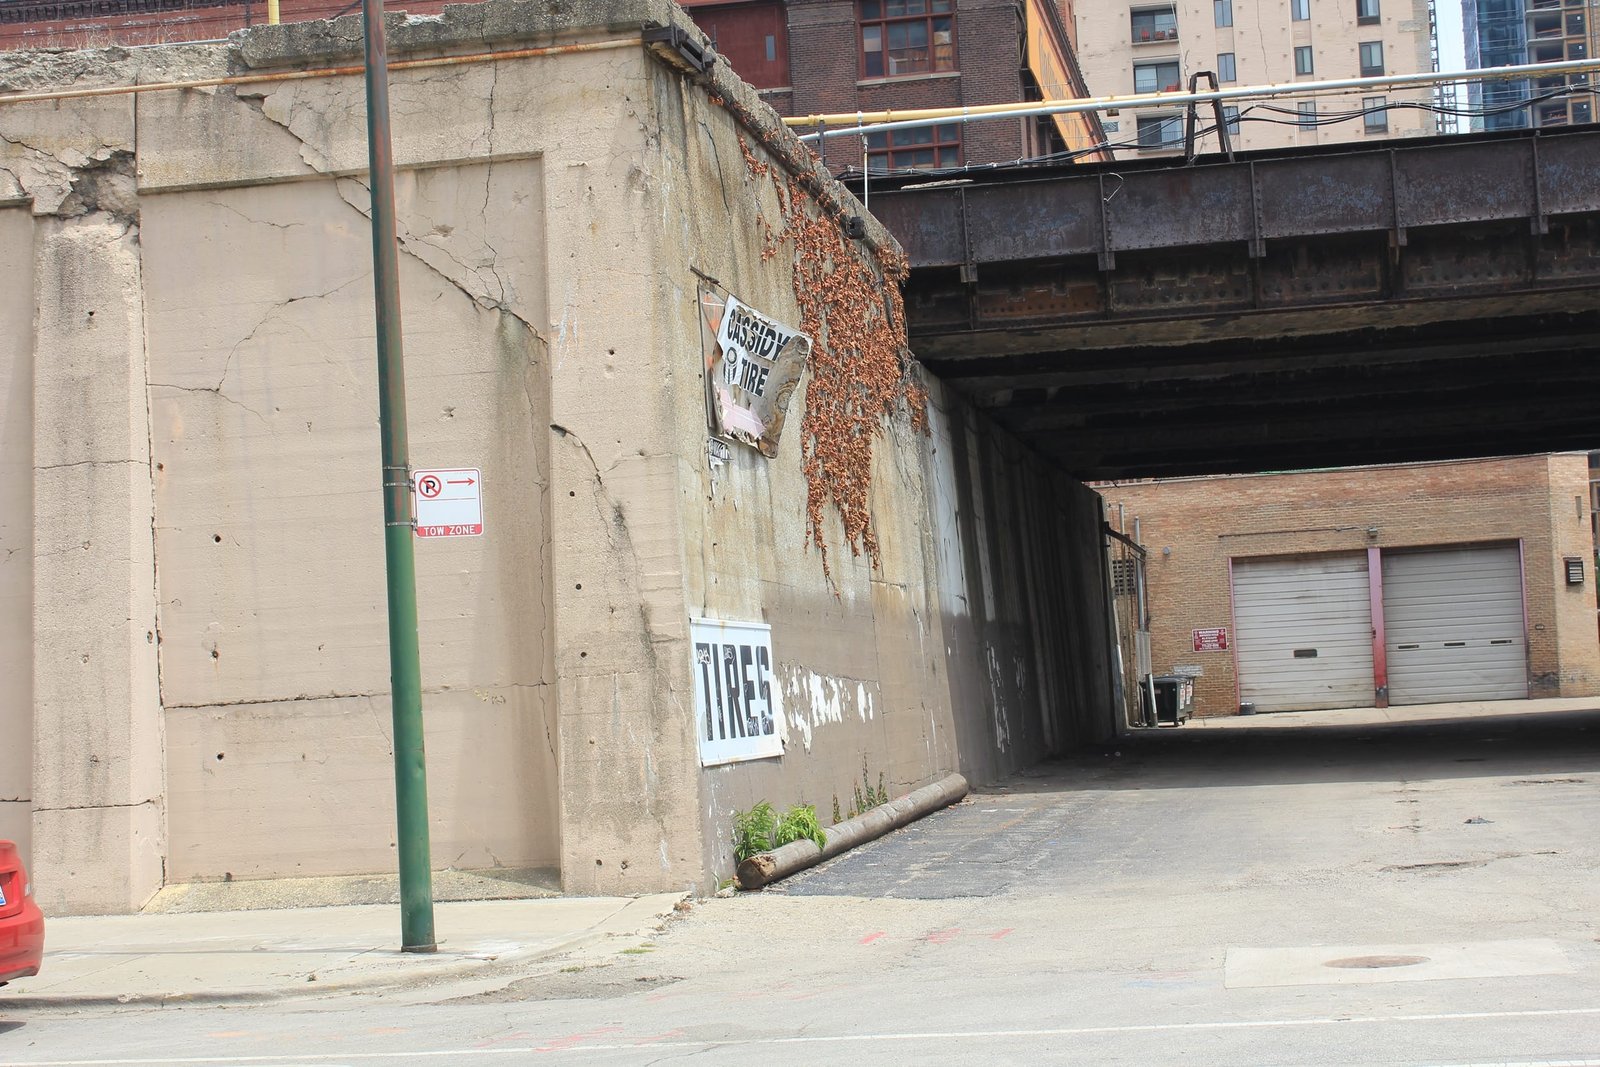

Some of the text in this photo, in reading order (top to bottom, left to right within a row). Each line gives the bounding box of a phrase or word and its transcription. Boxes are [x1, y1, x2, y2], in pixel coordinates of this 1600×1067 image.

[727, 308, 791, 362] CASSIDY
[739, 357, 769, 397] TIRE
[424, 525, 476, 536] TOW ZONE
[695, 642, 775, 741] TIRES
